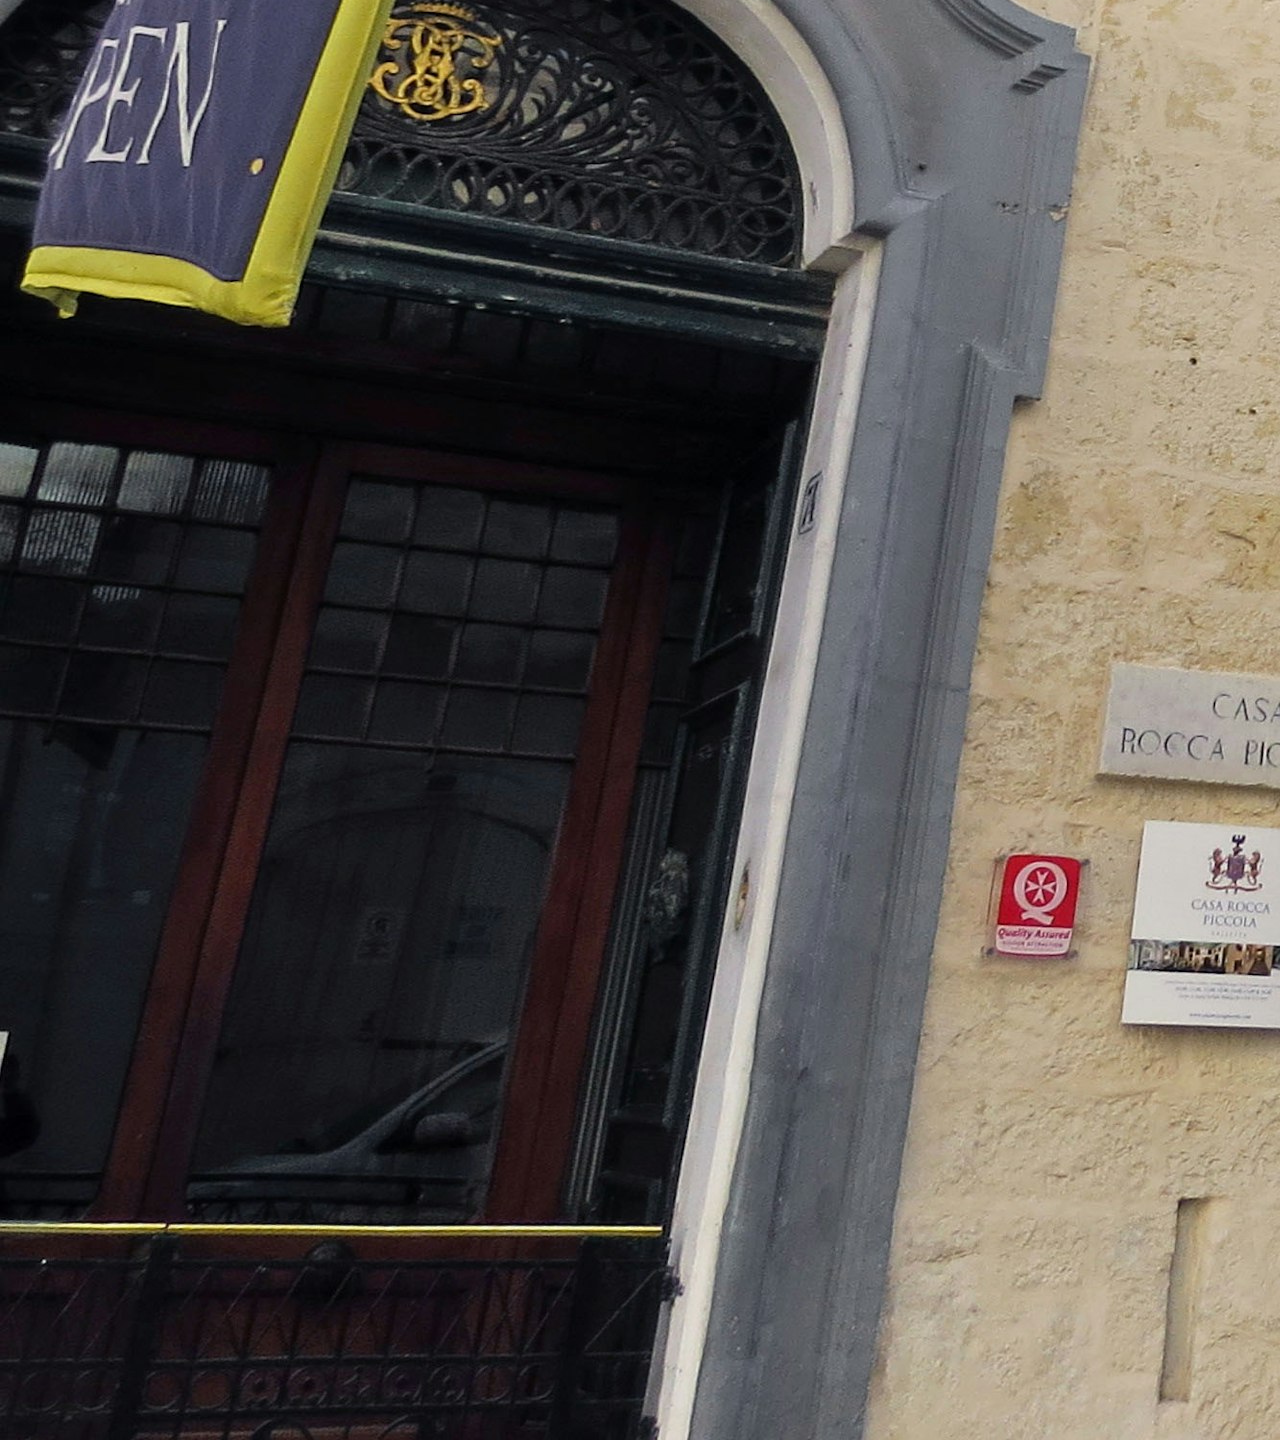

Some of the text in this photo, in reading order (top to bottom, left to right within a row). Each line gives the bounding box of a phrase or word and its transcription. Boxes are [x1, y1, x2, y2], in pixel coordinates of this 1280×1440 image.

[48, 20, 227, 170] PEN
[1120, 727, 1225, 761] ROCCA
[1191, 900, 1270, 914] CASA ROCCA
[1203, 915, 1257, 928] PICCOLA
[998, 928, 1070, 939] Quality Assured
